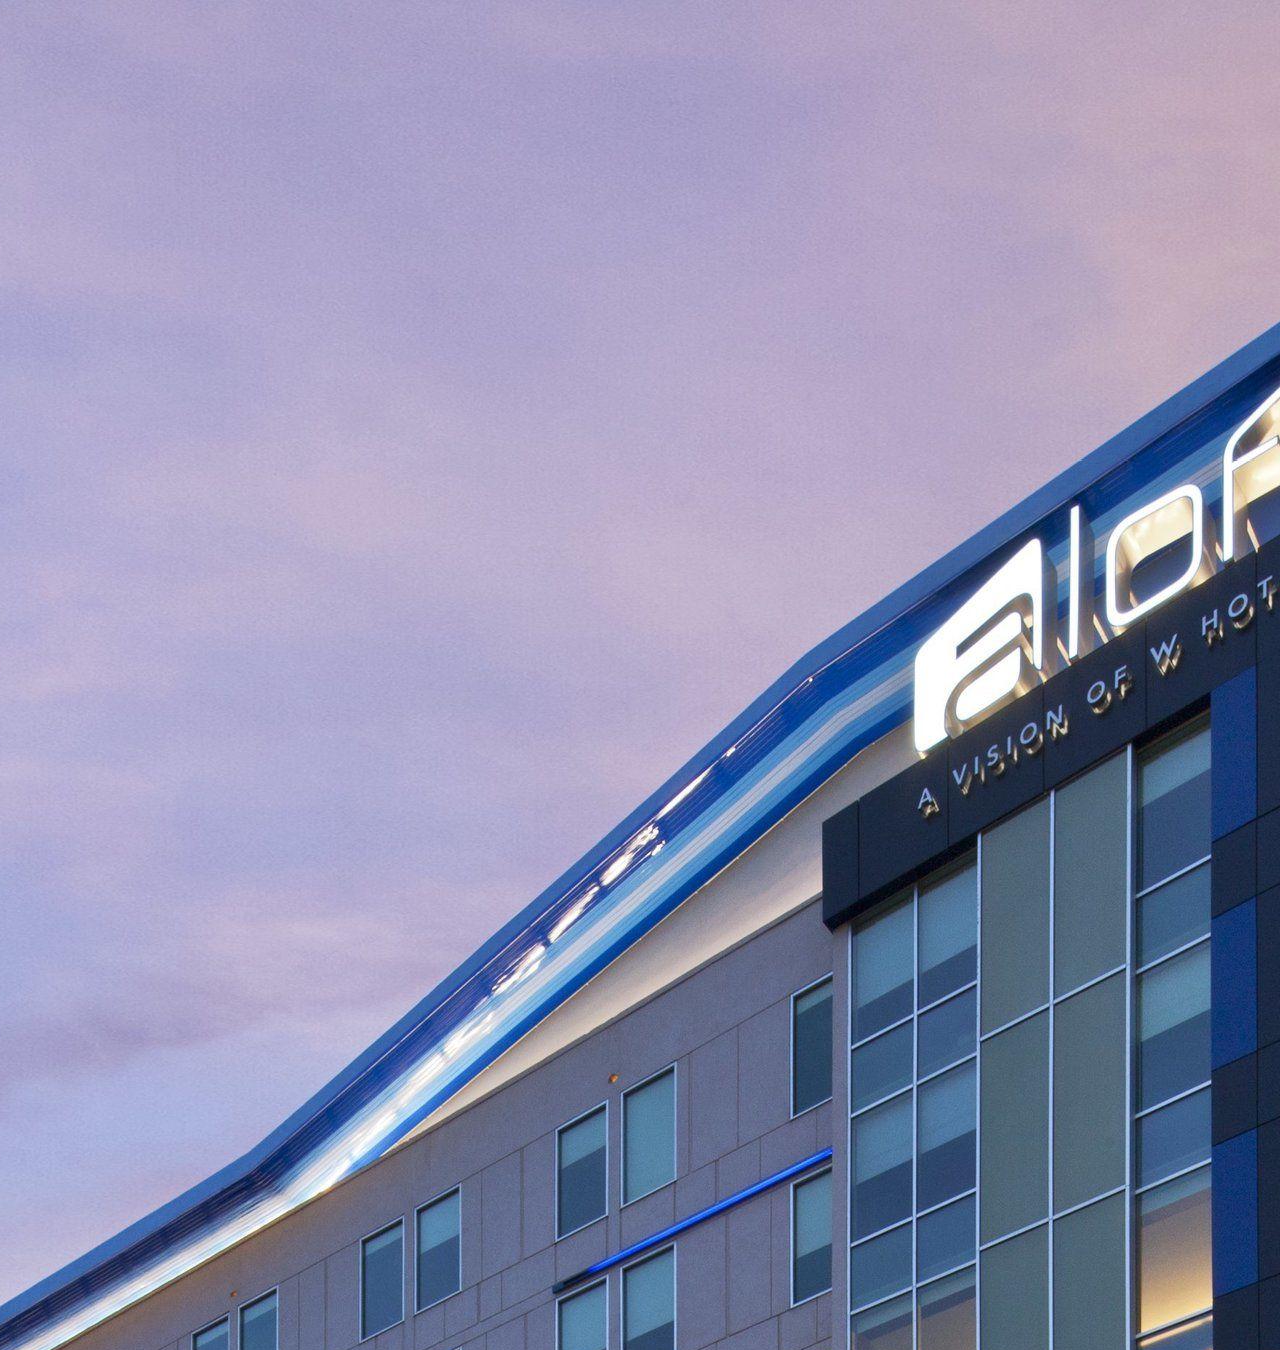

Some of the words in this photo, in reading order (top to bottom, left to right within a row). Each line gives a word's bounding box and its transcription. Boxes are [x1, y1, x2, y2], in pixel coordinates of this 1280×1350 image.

[917, 787, 937, 814] A
[951, 703, 1066, 791] VISION
[1086, 664, 1131, 709] OF
[1150, 633, 1180, 672] W
